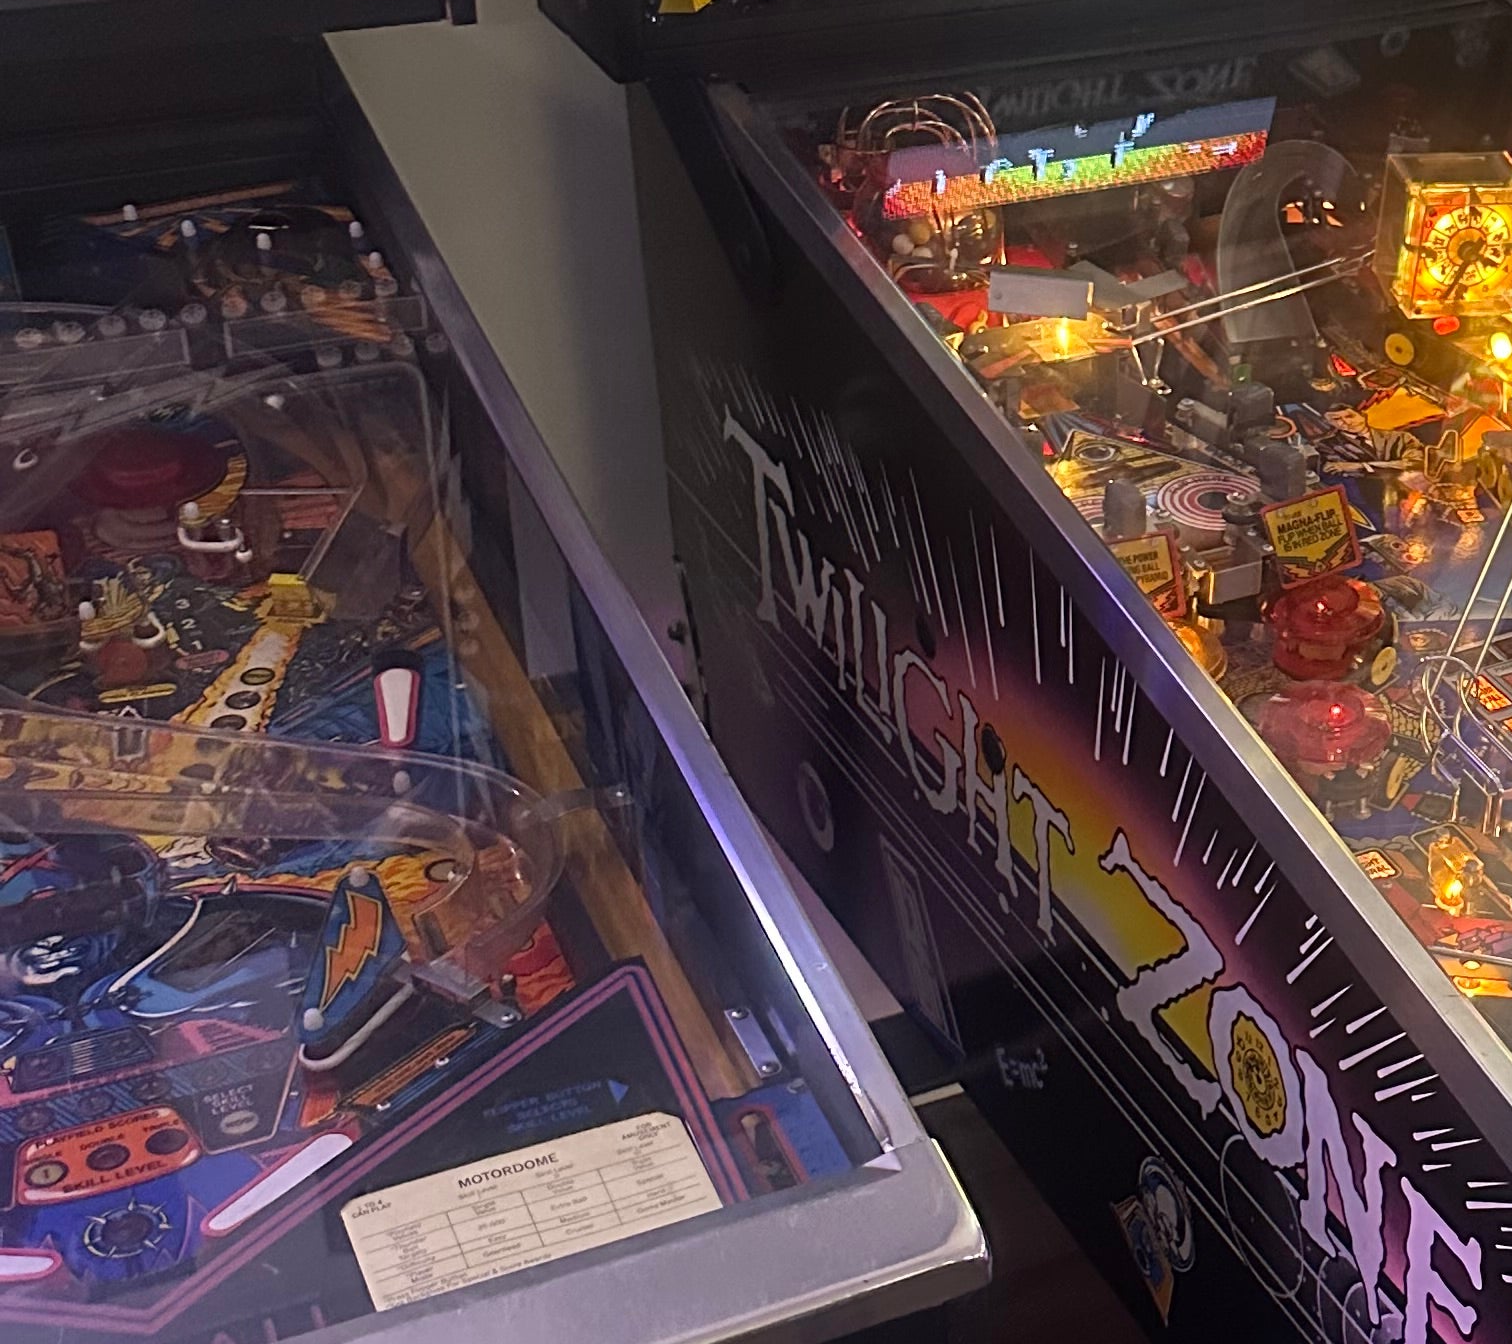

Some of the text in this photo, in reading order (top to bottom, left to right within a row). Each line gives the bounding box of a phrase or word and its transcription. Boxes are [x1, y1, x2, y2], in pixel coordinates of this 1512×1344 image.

[723, 403, 1076, 948] TWILIGHT
[203, 1084, 255, 1103] SELECT
[108, 1109, 160, 1130] SCORES
[62, 1159, 169, 1194] SKILL LEVEL
[457, 1152, 560, 1191] MOTORDOME
